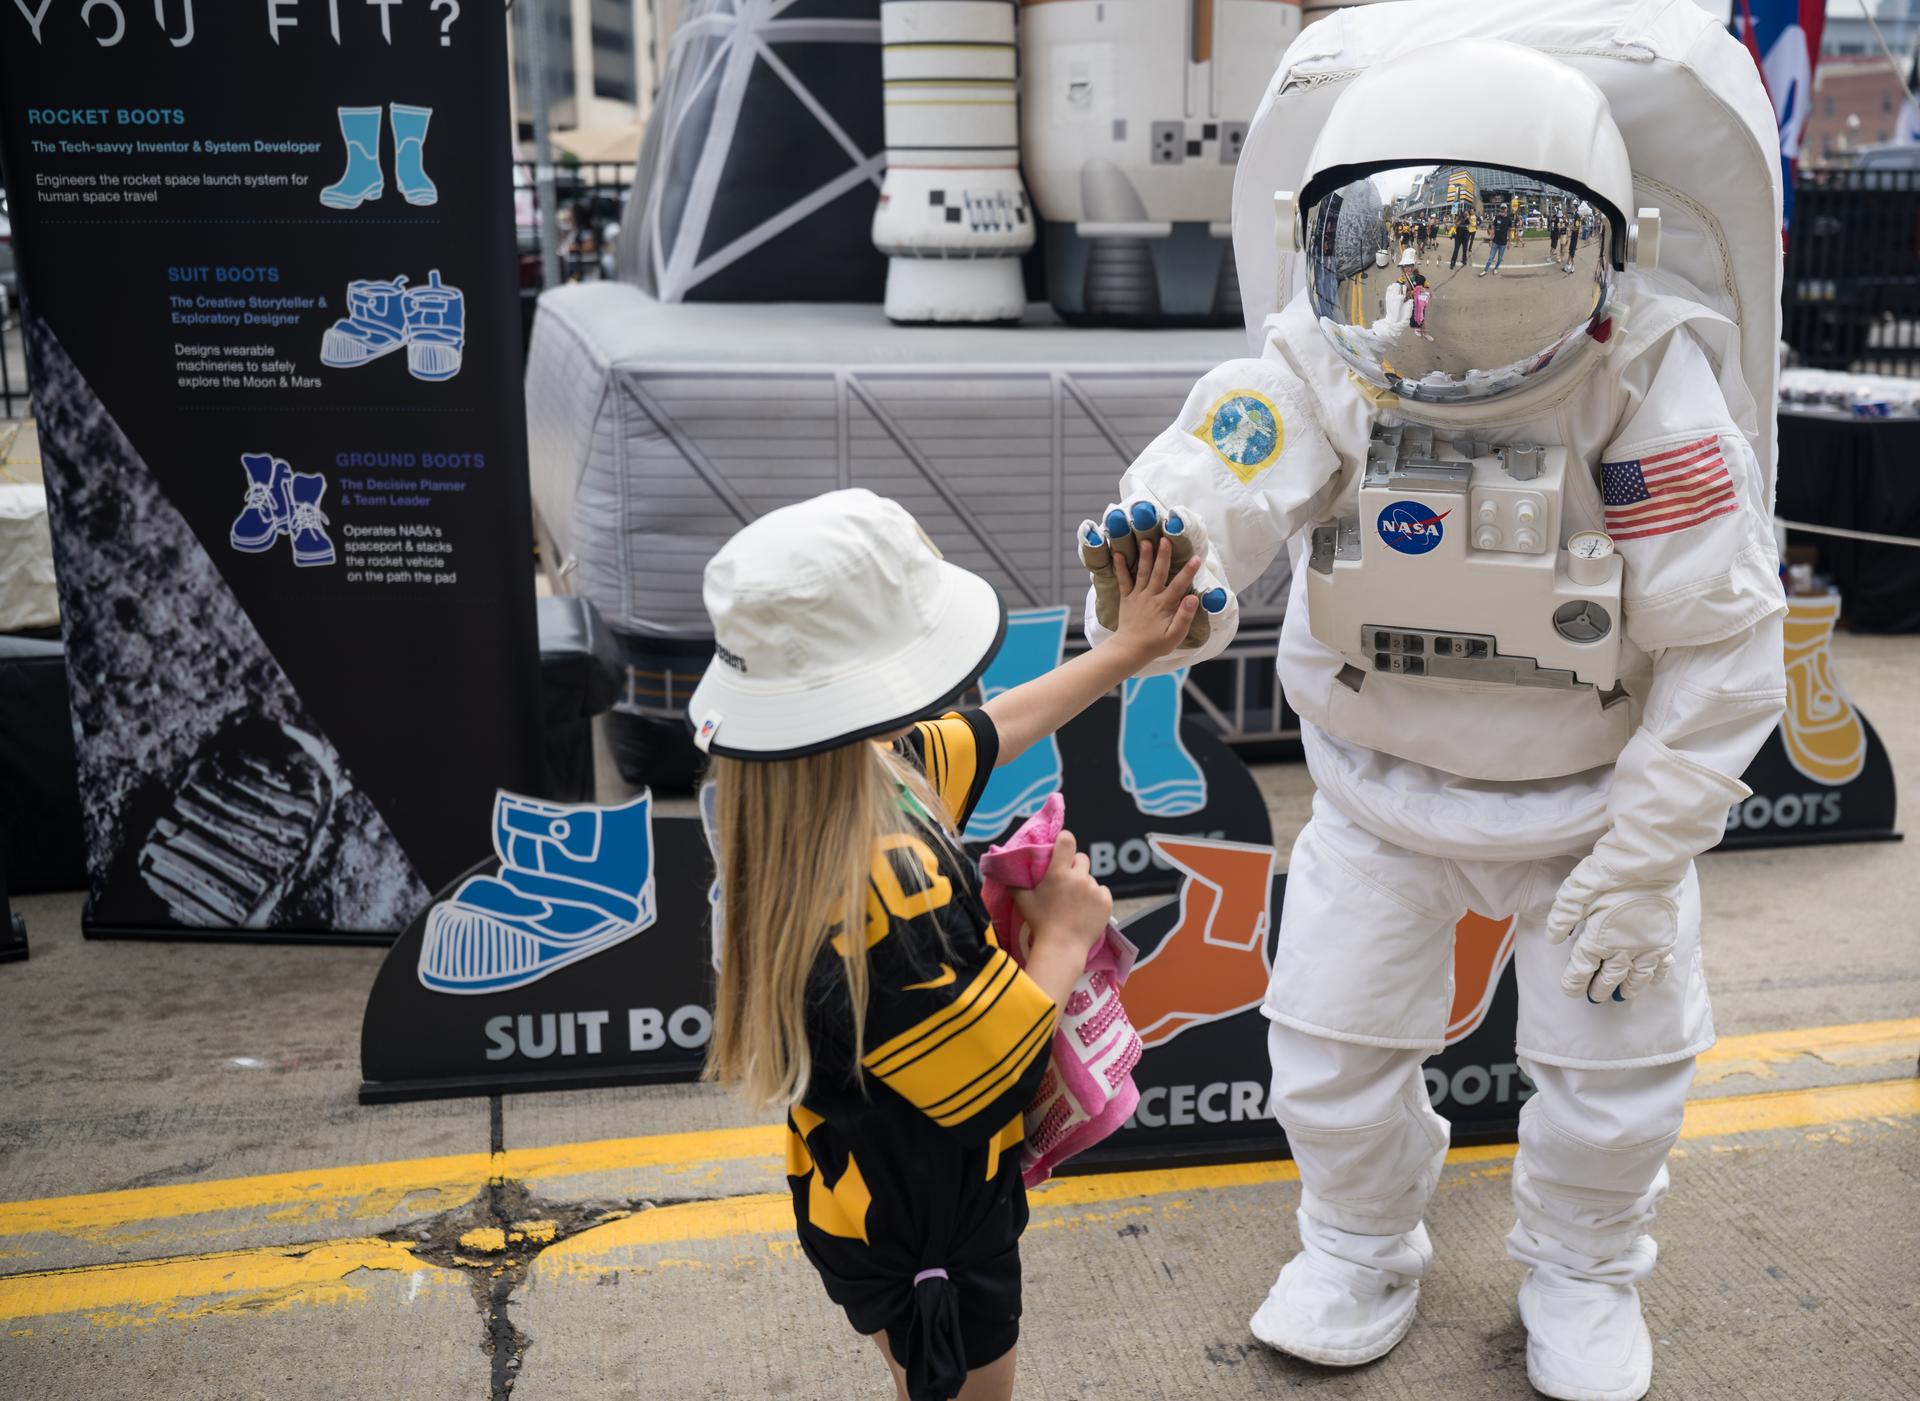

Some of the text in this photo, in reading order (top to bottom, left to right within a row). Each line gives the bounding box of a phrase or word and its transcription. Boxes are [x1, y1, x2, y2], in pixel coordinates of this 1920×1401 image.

[14, 0, 461, 48] YOU FIT?
[28, 109, 185, 125] ROCKET BOOTS
[32, 140, 321, 155] The Tech-savvy Inventor & System Developer
[36, 172, 309, 190] Engineers the rocket space launch system for
[38, 190, 158, 204] human space travel
[168, 266, 280, 283] SUIT BOOTS
[170, 296, 328, 310] The Creative Storyteller &
[171, 312, 300, 327] Exploratory Designer
[174, 343, 275, 359] Designs wearable
[176, 360, 296, 375] machineries to safely
[178, 375, 322, 389] explore the Moon & Mars
[335, 452, 486, 469] GROUND BOOTS
[340, 478, 467, 492] The Decisive Planner
[341, 494, 431, 507] & Team Leader
[343, 524, 443, 539] Operates NASA's
[1382, 520, 1440, 537] NASA
[344, 540, 453, 554] spaceport & stacks
[346, 555, 445, 569] the rocket vehicle
[347, 571, 457, 585] on the path the pad
[1454, 643, 1464, 653] 3
[1393, 659, 1401, 669] 5
[484, 1010, 610, 1061] SUIT
